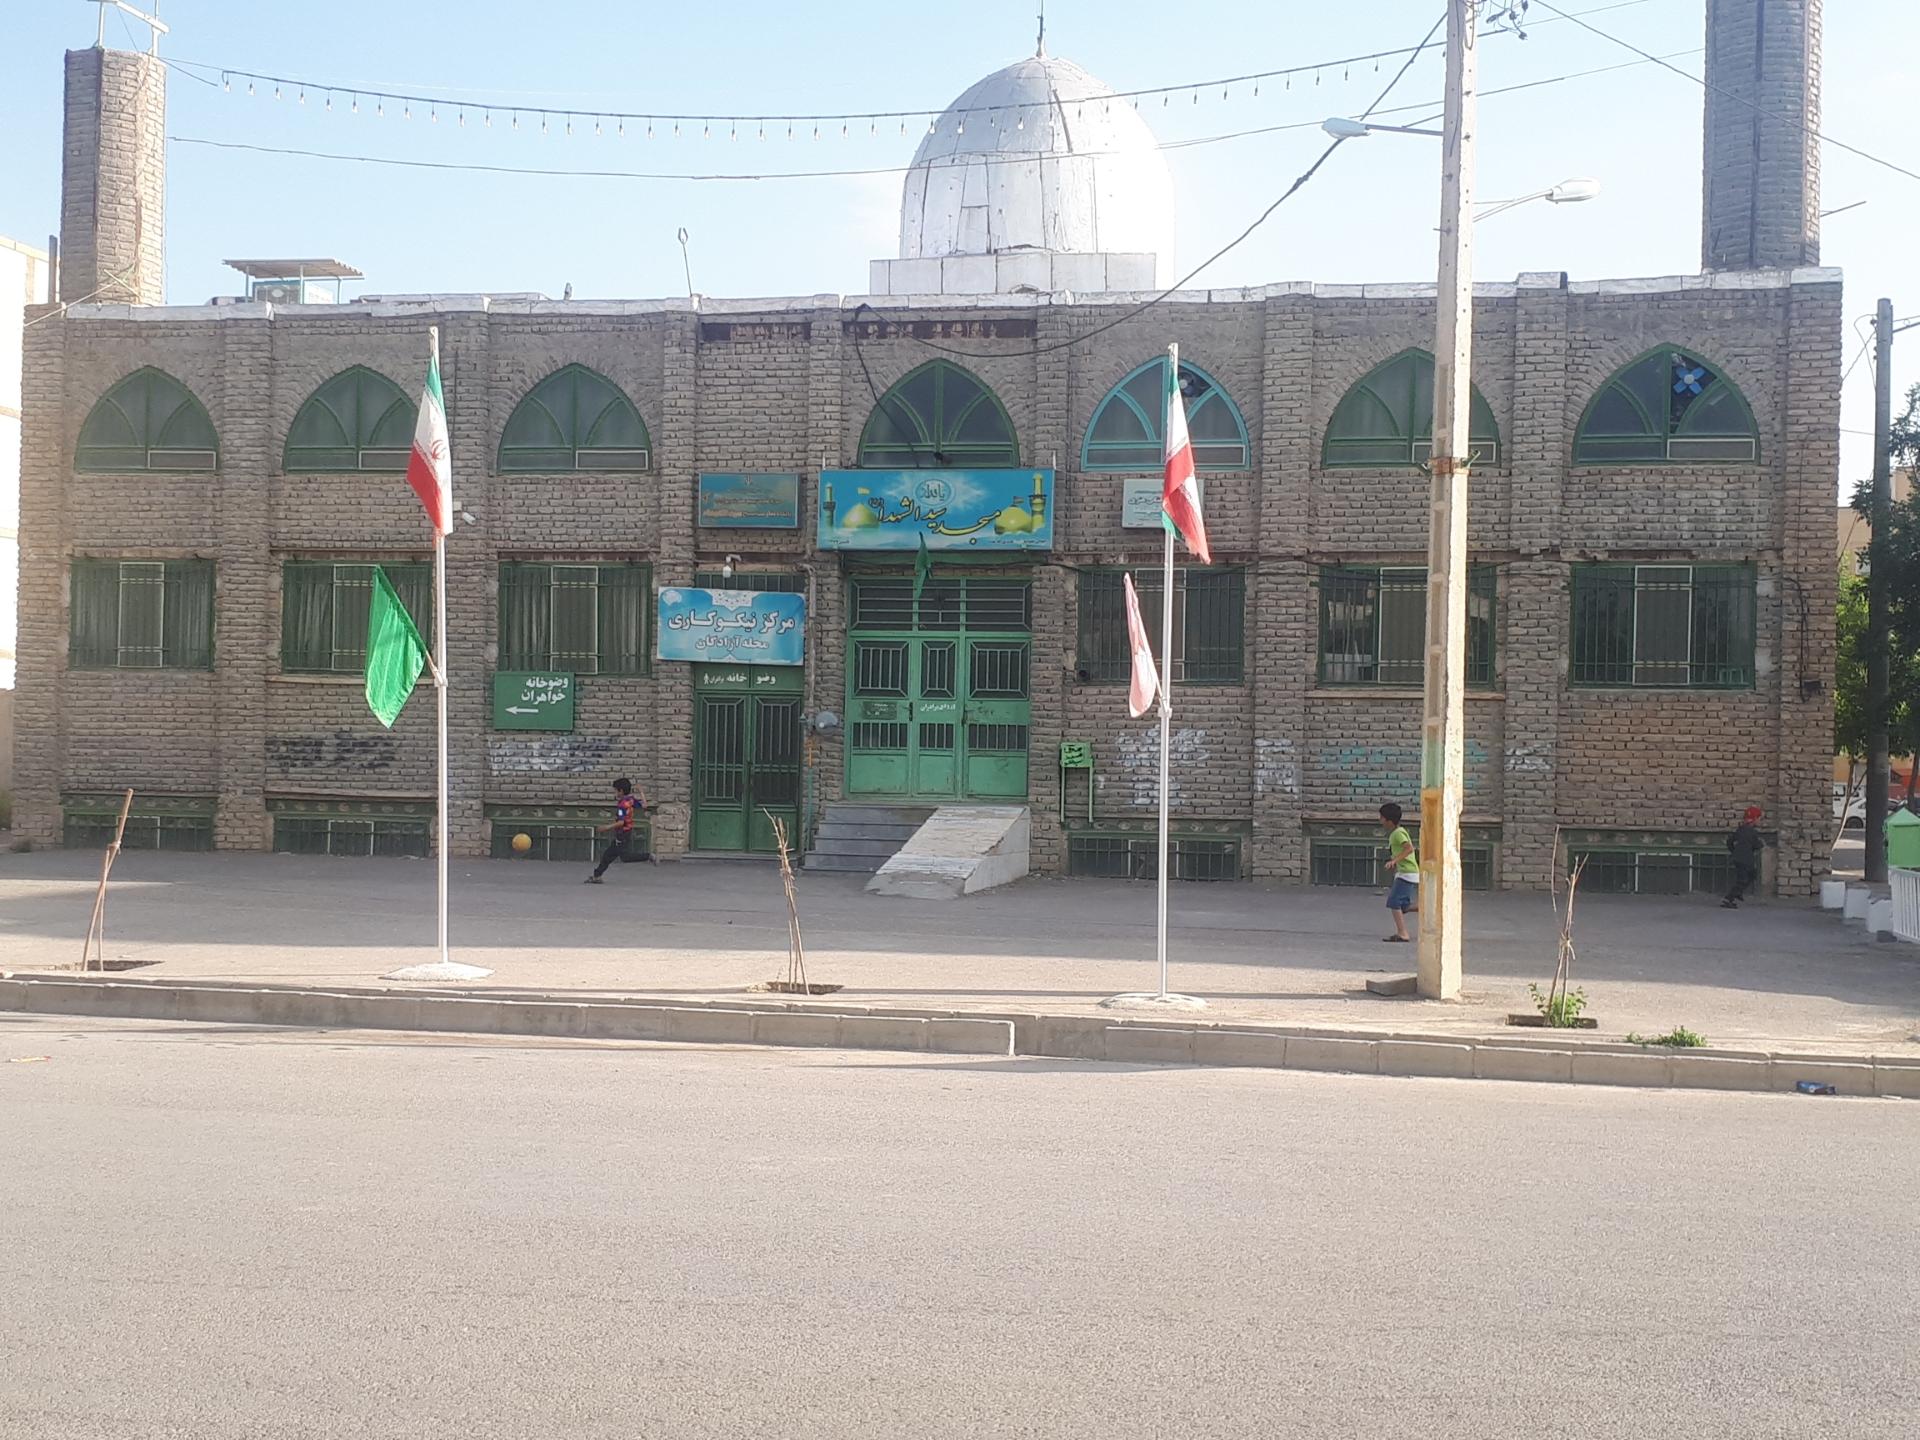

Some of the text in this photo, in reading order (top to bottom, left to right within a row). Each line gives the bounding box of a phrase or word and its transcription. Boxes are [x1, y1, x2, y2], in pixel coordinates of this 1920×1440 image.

[931, 509, 1001, 545] مسجد
[668, 609, 796, 634] مرکز نیکوکاری
[695, 634, 769, 651] محله آزادگان
[525, 676, 569, 690] وضوخانه
[727, 672, 747, 683] خانه
[756, 673, 776, 684] وضو
[521, 689, 566, 704] خواهران
